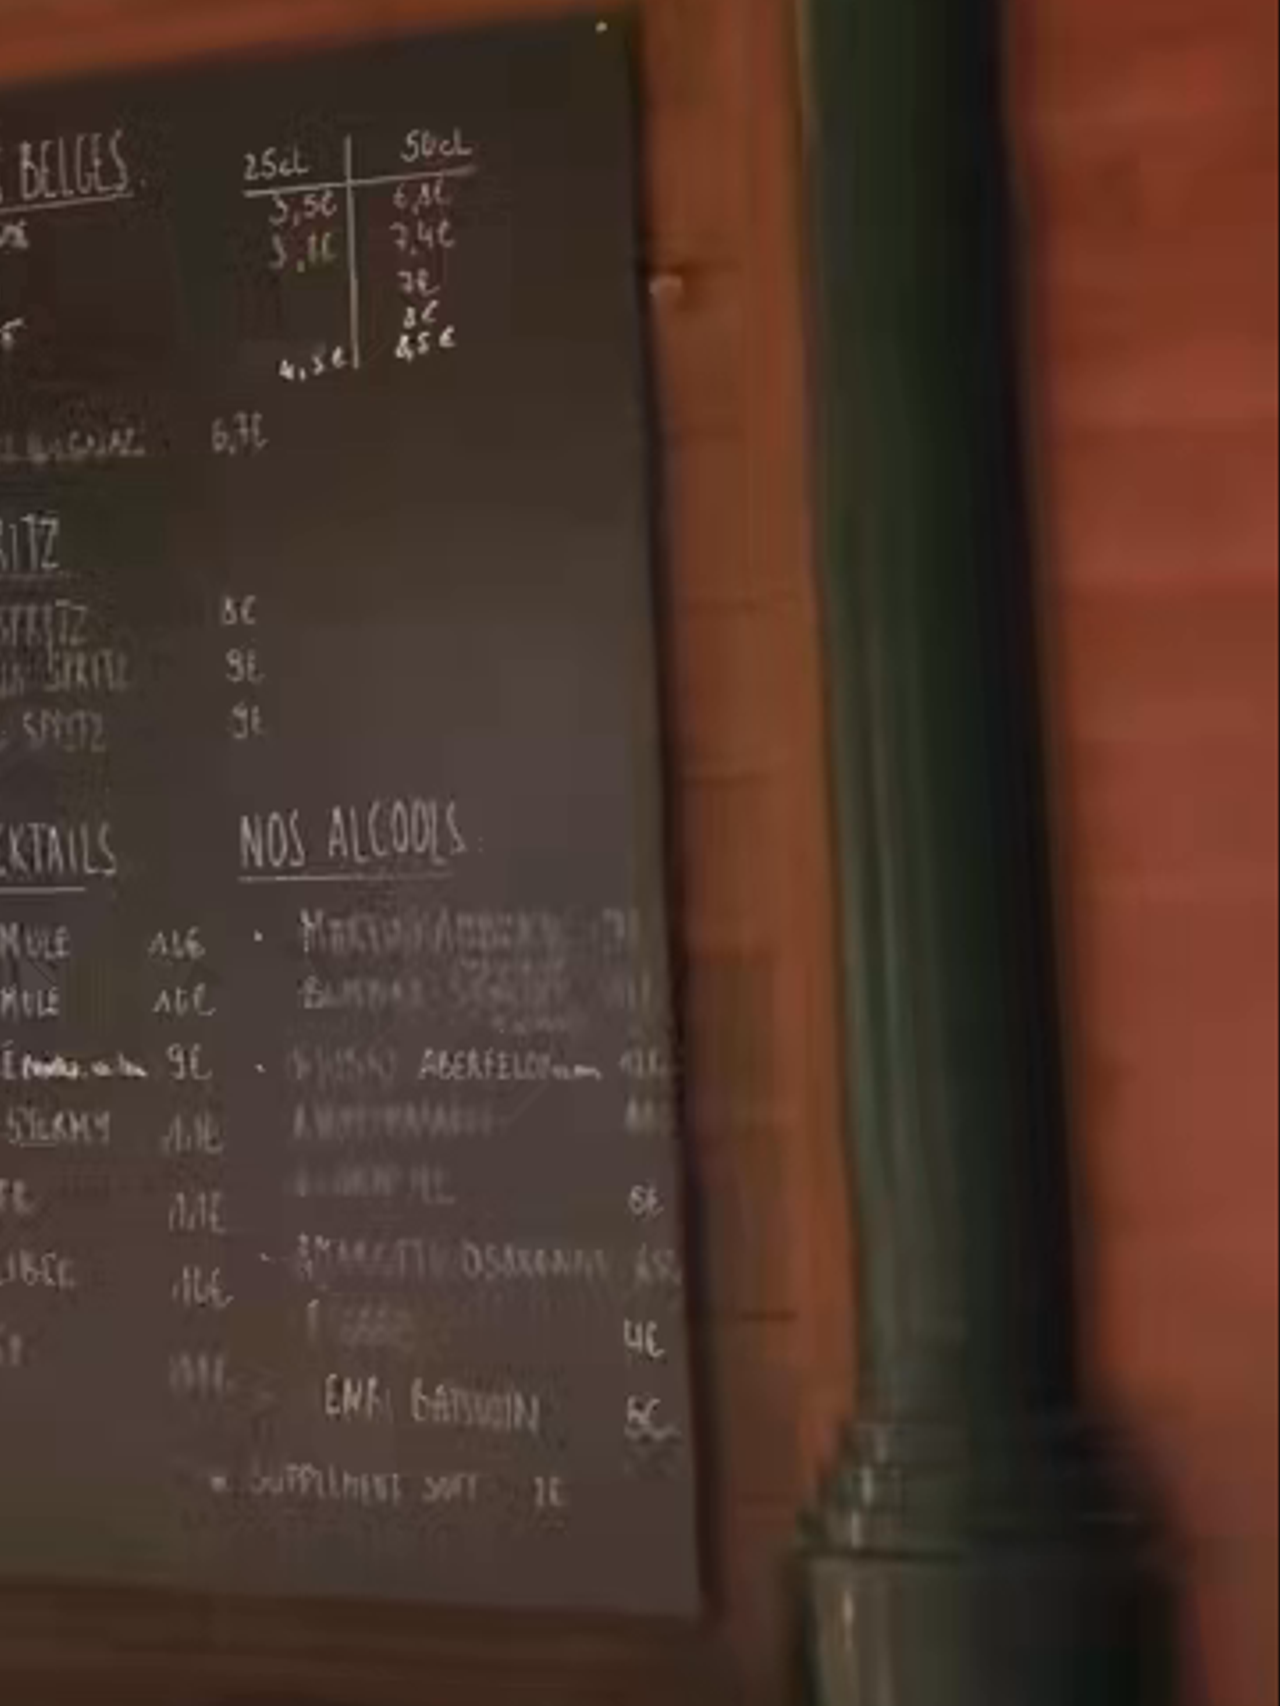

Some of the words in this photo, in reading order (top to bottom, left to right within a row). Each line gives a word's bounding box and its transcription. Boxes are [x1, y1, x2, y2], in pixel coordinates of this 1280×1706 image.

[19, 129, 130, 200] BELGES
[239, 809, 306, 869] NOS
[328, 797, 469, 867] ALCOOLS
